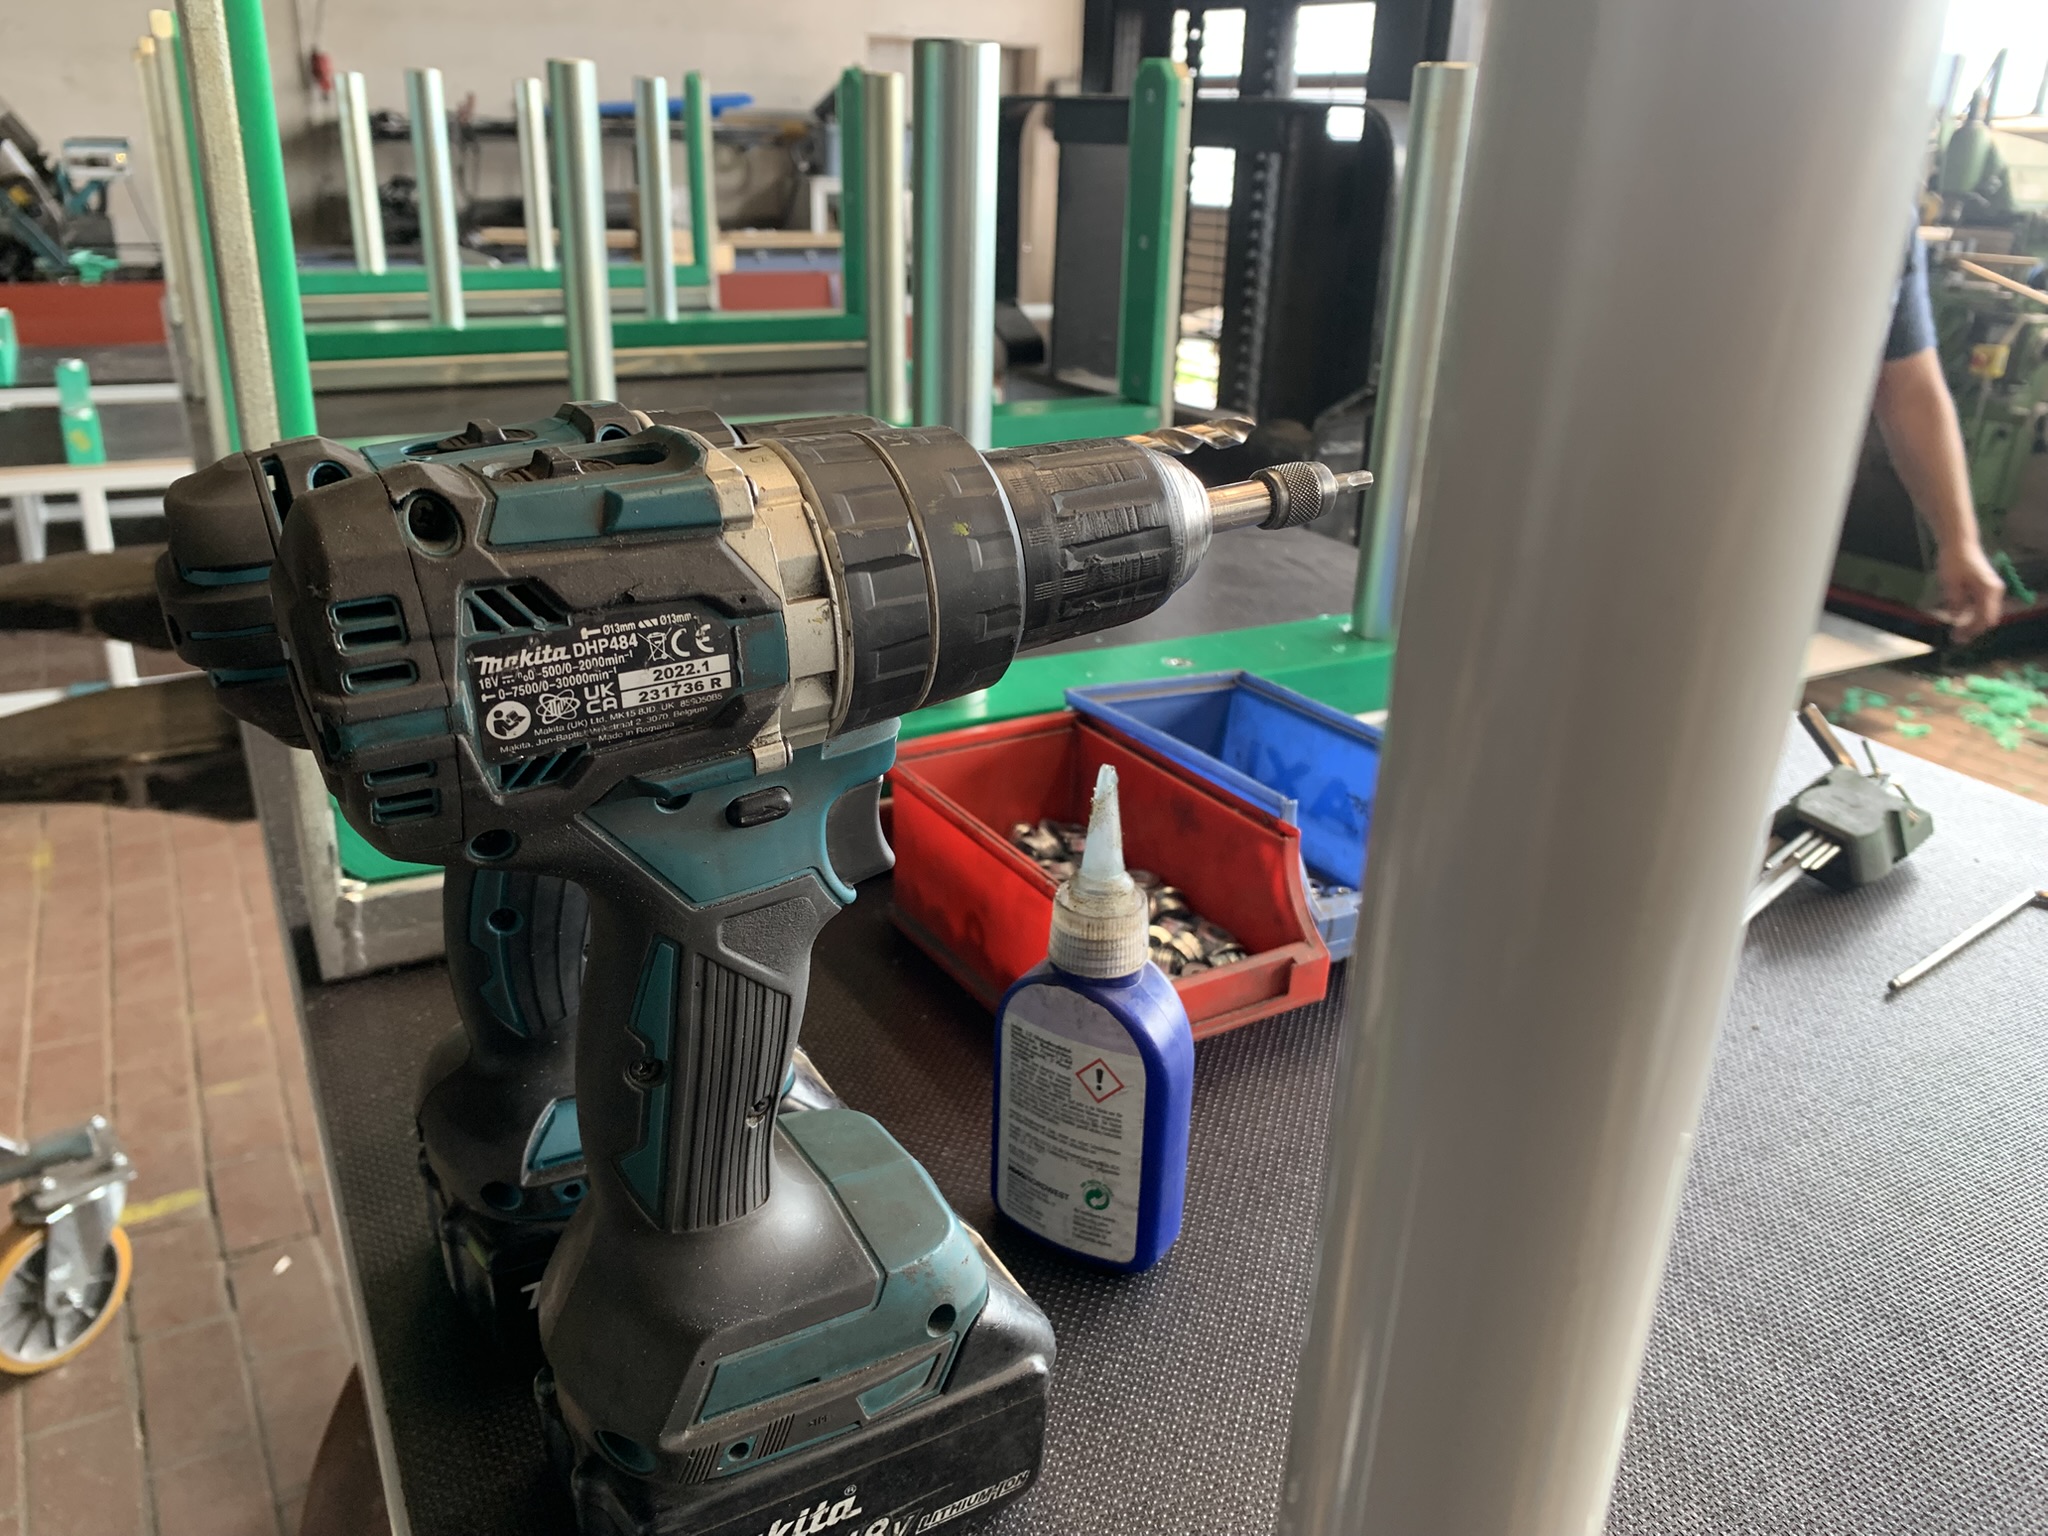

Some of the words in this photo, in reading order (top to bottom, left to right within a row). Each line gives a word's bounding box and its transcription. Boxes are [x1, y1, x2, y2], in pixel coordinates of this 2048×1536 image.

[572, 633, 638, 658] DHP484
[653, 660, 710, 682] 2022.1
[479, 676, 499, 690] 18V
[584, 682, 615, 700] UK
[638, 681, 705, 703] 231736
[710, 677, 722, 689] R
[586, 697, 618, 714] CA
[673, 706, 708, 718] Belgium
[534, 725, 565, 737] Makita
[567, 719, 588, 731] (UK)
[610, 710, 637, 721] MK15
[661, 702, 675, 711] UK
[598, 732, 623, 742] Made
[636, 722, 675, 734] Romania
